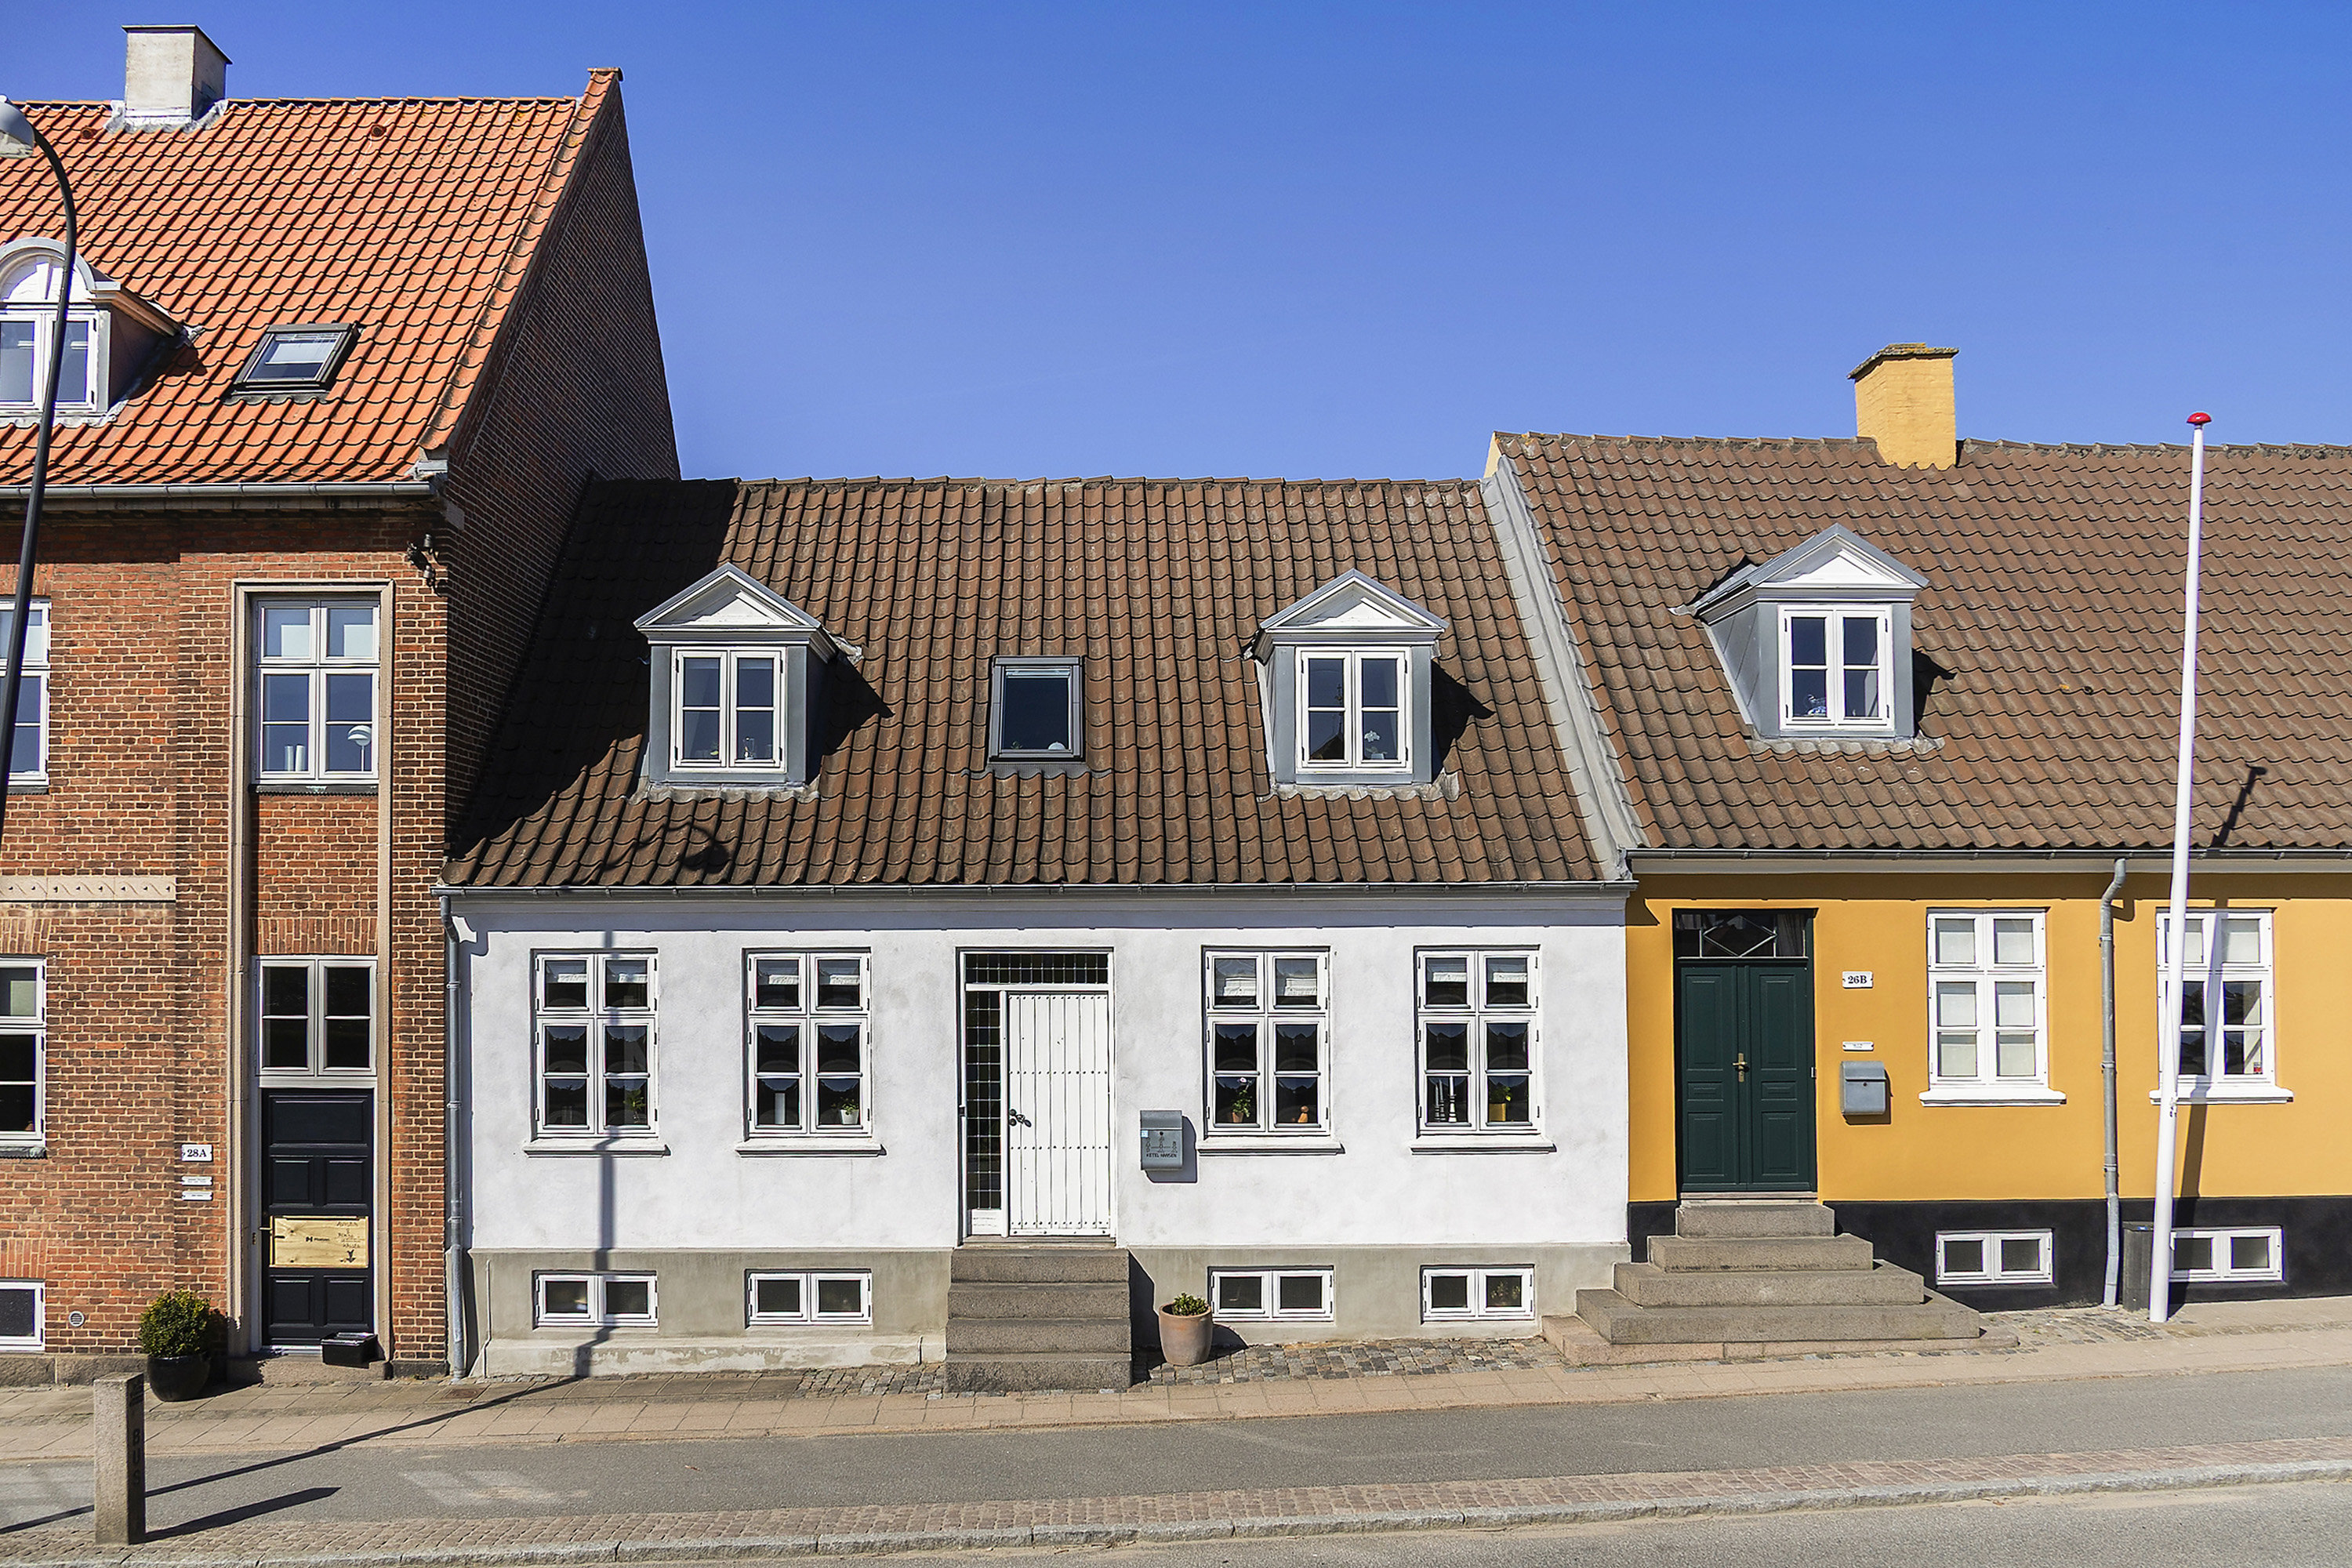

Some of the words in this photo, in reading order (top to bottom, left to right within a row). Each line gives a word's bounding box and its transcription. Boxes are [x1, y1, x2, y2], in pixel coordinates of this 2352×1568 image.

[1848, 975, 1867, 984] 26B
[187, 1149, 207, 1157] 28A
[132, 1428, 141, 1485] BUS
